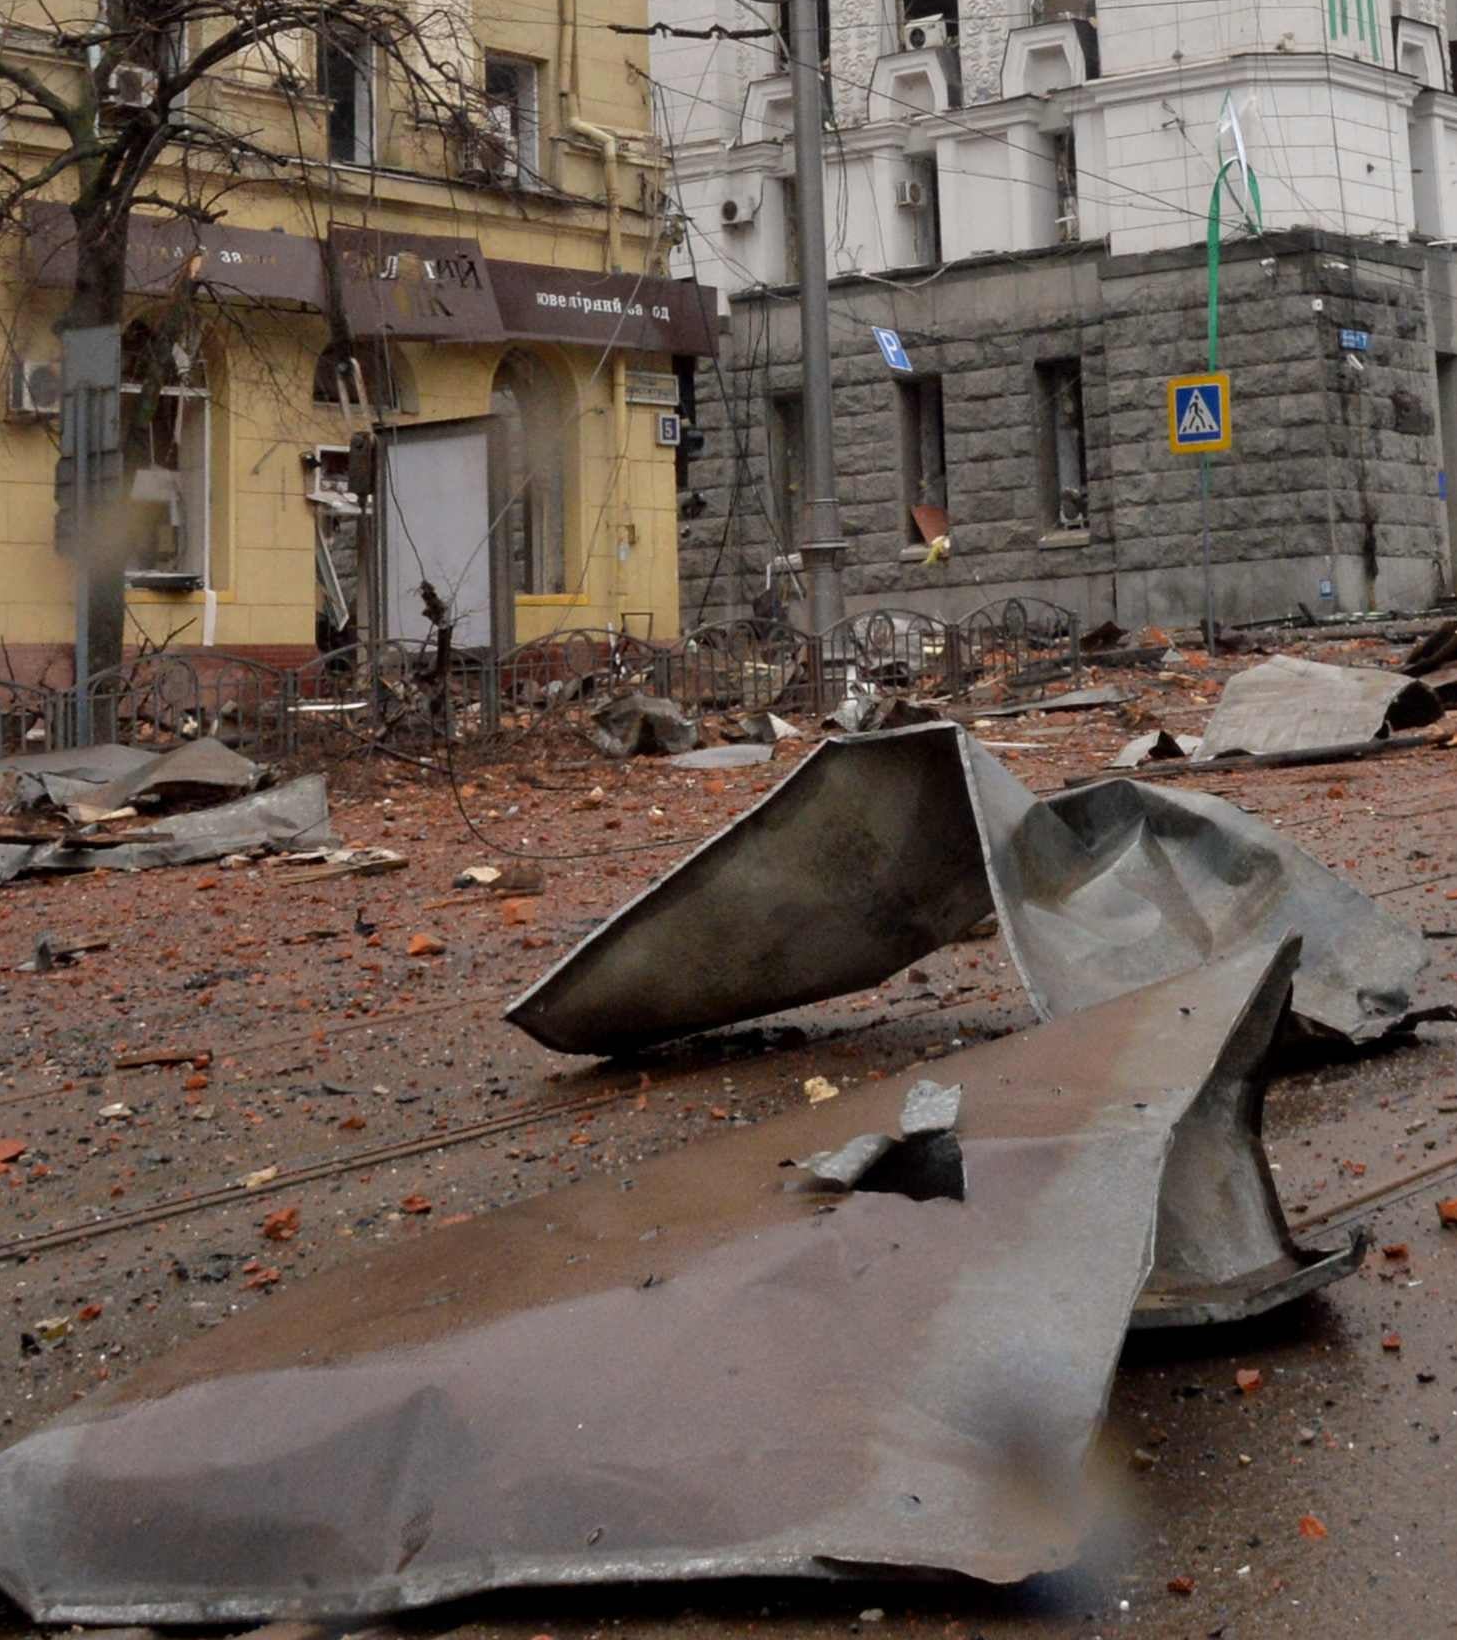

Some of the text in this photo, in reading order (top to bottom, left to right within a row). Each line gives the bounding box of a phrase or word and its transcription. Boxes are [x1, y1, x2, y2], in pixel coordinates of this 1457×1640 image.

[536, 291, 671, 322] ювелірний аод
[879, 331, 897, 362] P
[664, 421, 673, 438] 5
